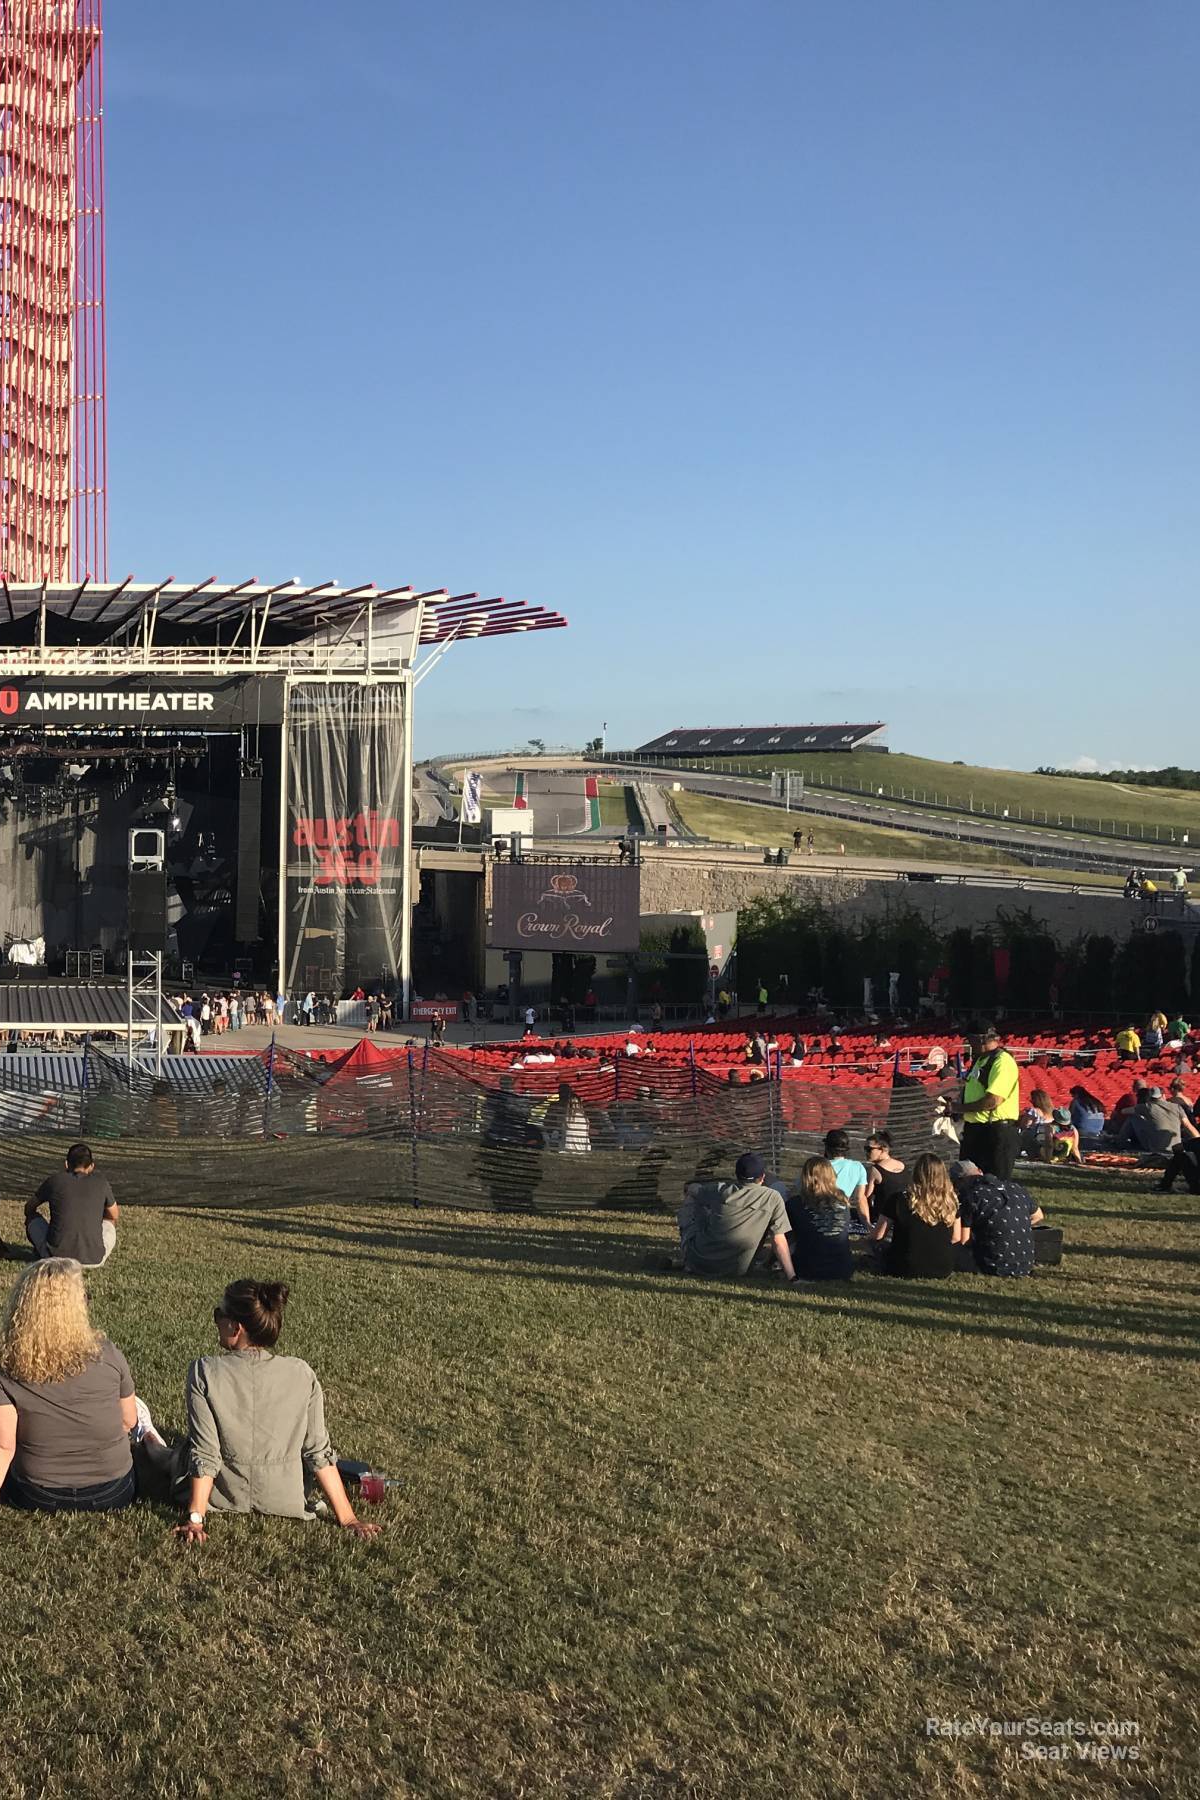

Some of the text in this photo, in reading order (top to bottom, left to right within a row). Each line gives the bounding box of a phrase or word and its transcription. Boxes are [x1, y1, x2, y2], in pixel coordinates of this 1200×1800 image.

[25, 692, 214, 711] AMPHITHEATER
[294, 810, 399, 848] austin
[314, 849, 381, 885] 360
[517, 912, 613, 940] Crown Royal
